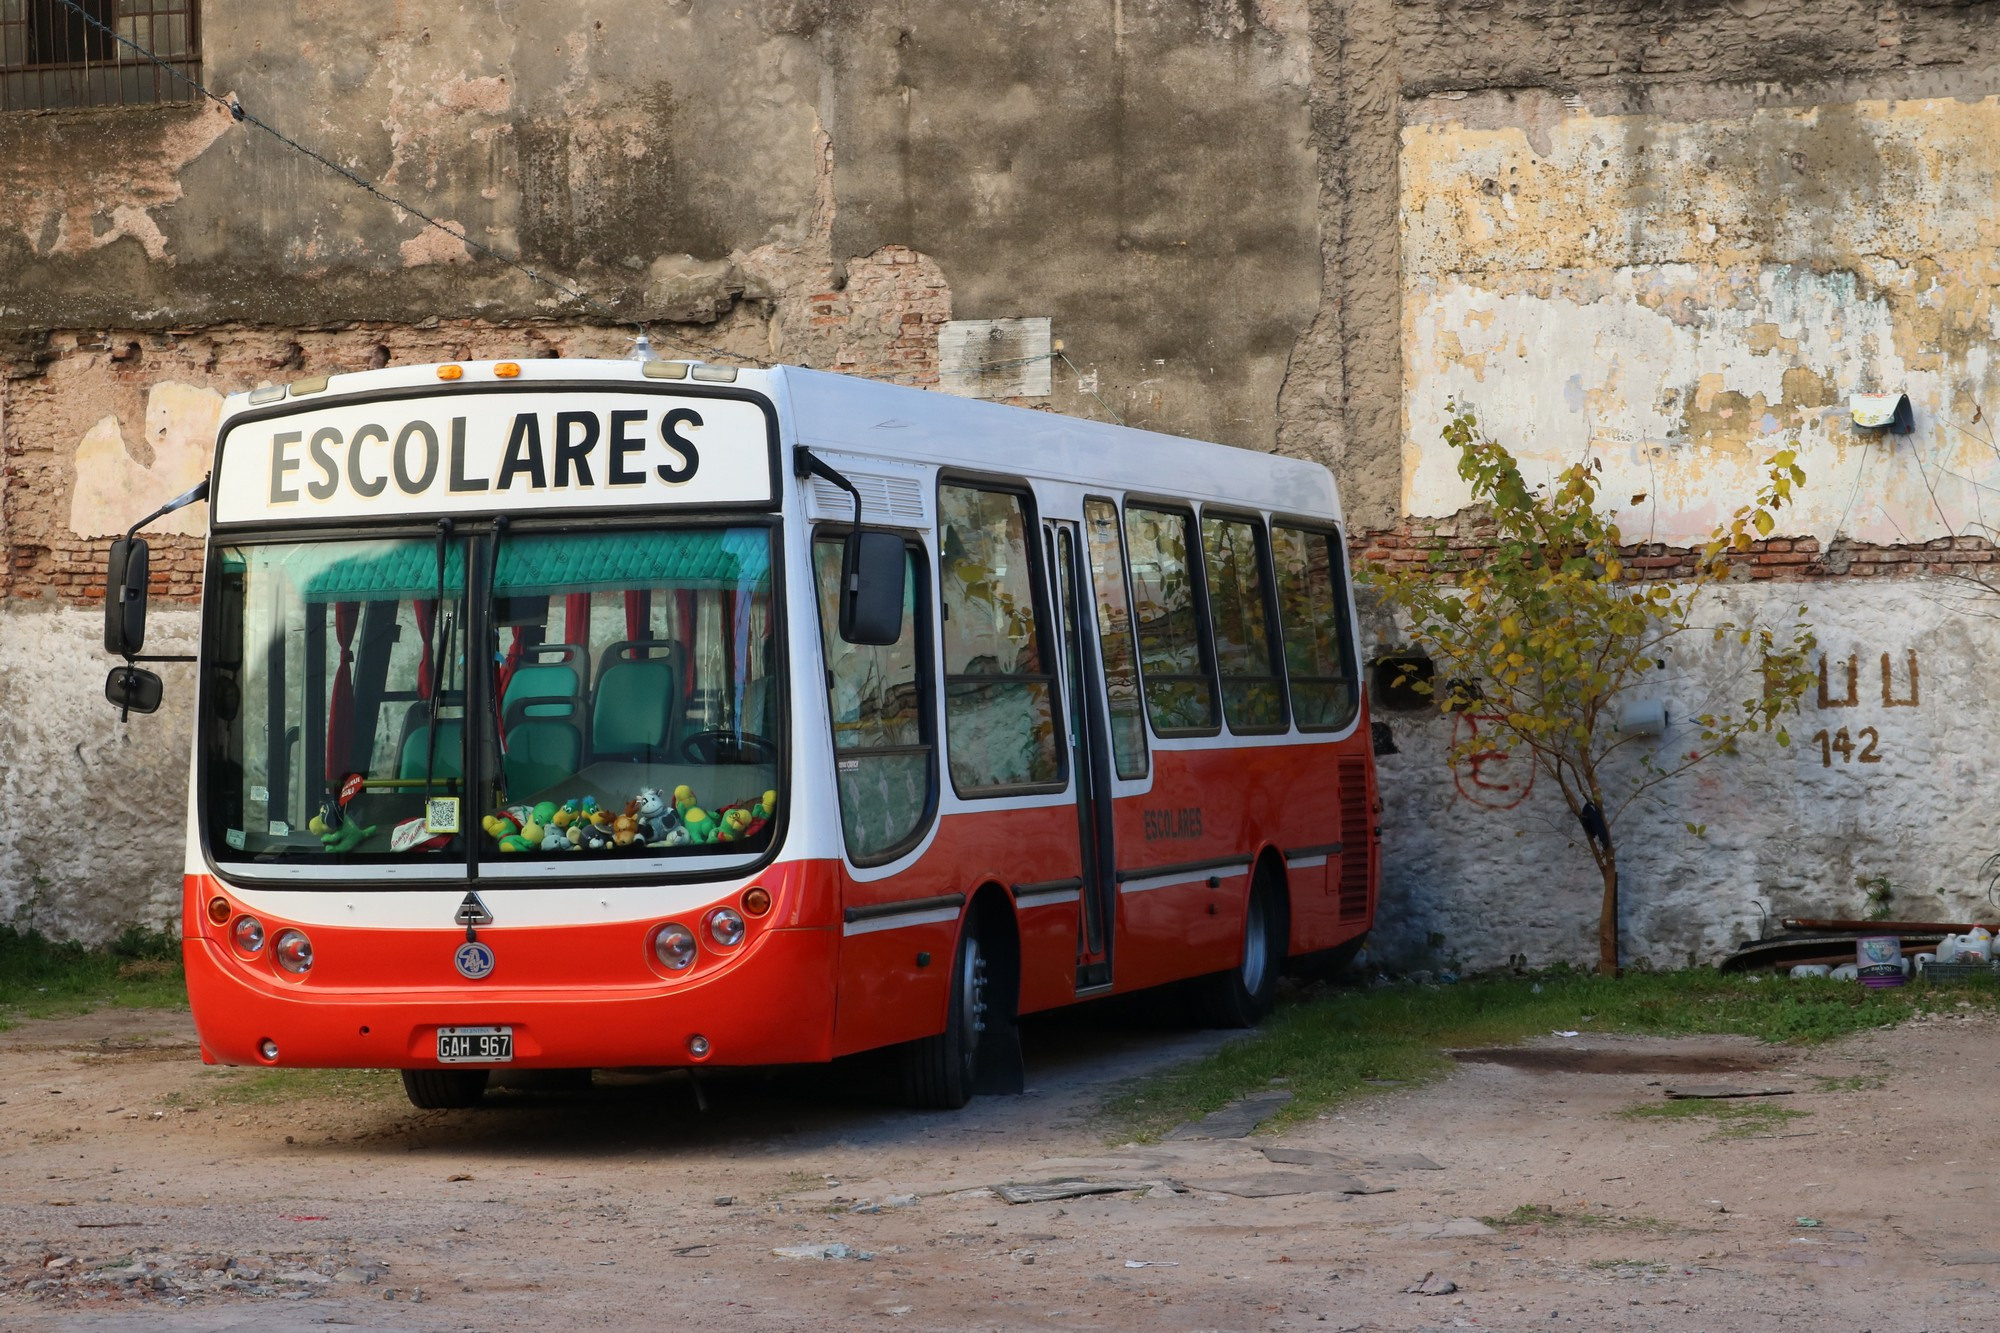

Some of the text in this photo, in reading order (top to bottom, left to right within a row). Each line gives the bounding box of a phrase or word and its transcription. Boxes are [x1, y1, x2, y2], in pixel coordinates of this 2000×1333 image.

[269, 407, 704, 504] ESCOLARES
[1812, 726, 1882, 768] 142
[1144, 807, 1203, 841] ESCOLARES
[440, 1036, 509, 1057] GAH 967
